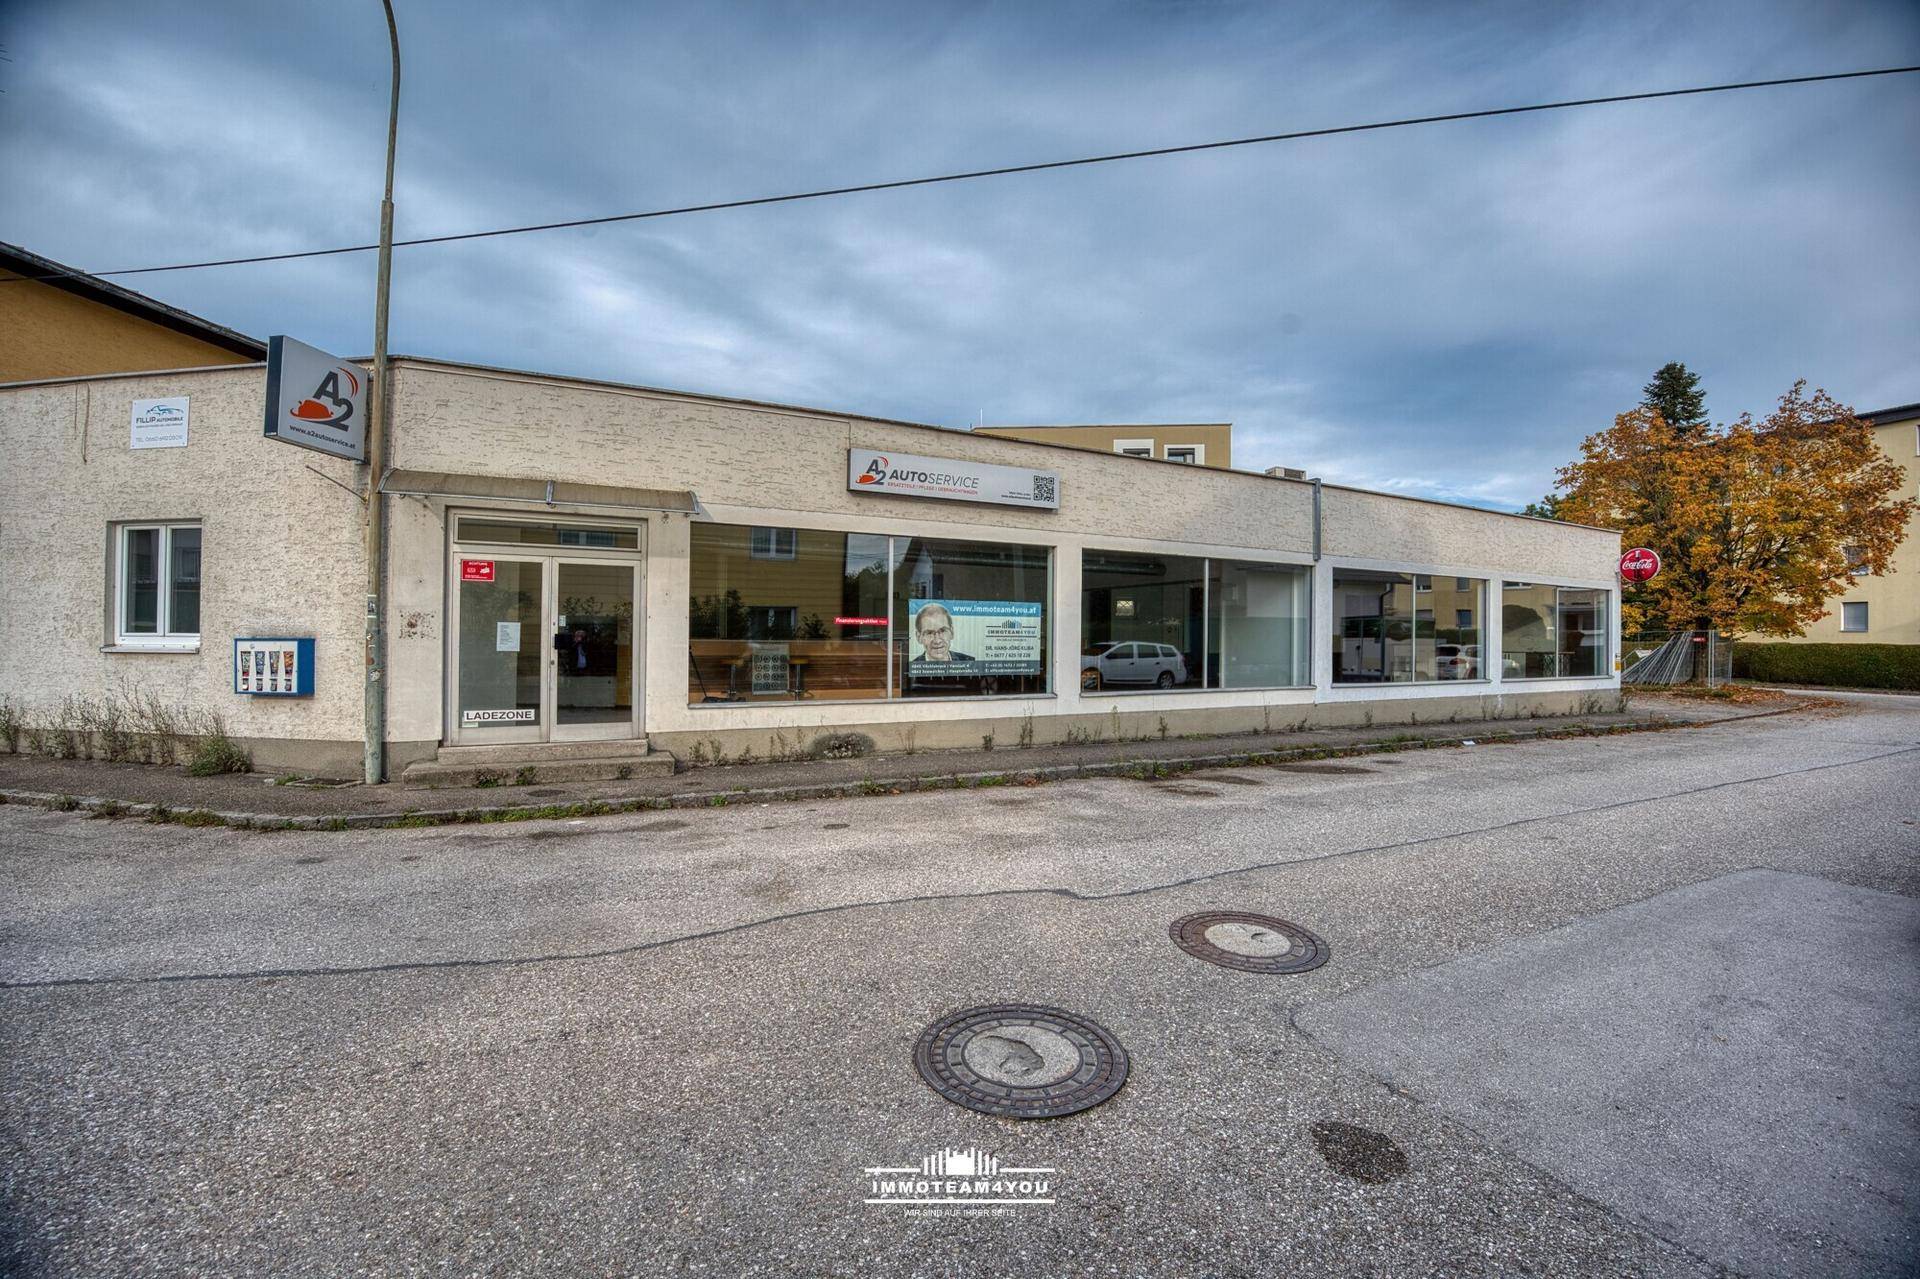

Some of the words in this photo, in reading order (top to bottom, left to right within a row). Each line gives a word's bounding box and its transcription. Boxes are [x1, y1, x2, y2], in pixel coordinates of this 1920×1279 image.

[289, 425, 356, 449] www.a2autoservice.at
[952, 605, 1037, 614] www.immoteam4you.at
[466, 710, 532, 720] LADEZONE
